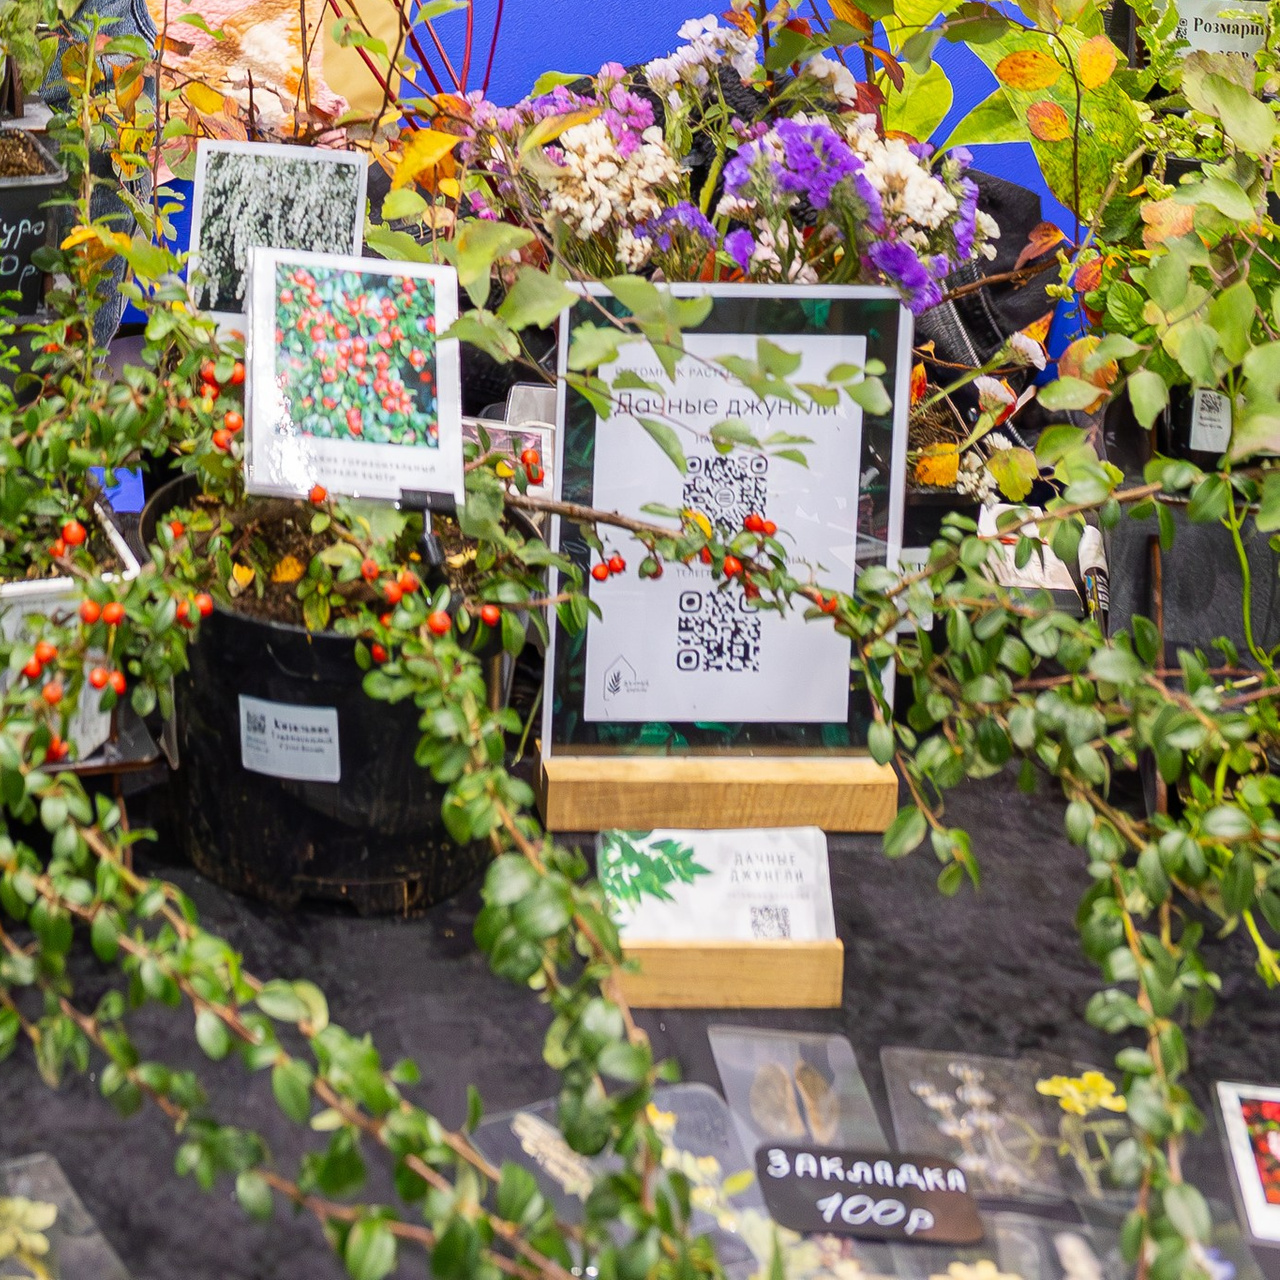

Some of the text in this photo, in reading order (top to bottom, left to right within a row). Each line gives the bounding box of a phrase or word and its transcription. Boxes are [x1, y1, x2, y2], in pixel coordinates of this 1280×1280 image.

[1193, 16, 1265, 40] Розмари
[613, 392, 719, 418] Дачные
[766, 1147, 968, 1194] ЗАКЛАДКА
